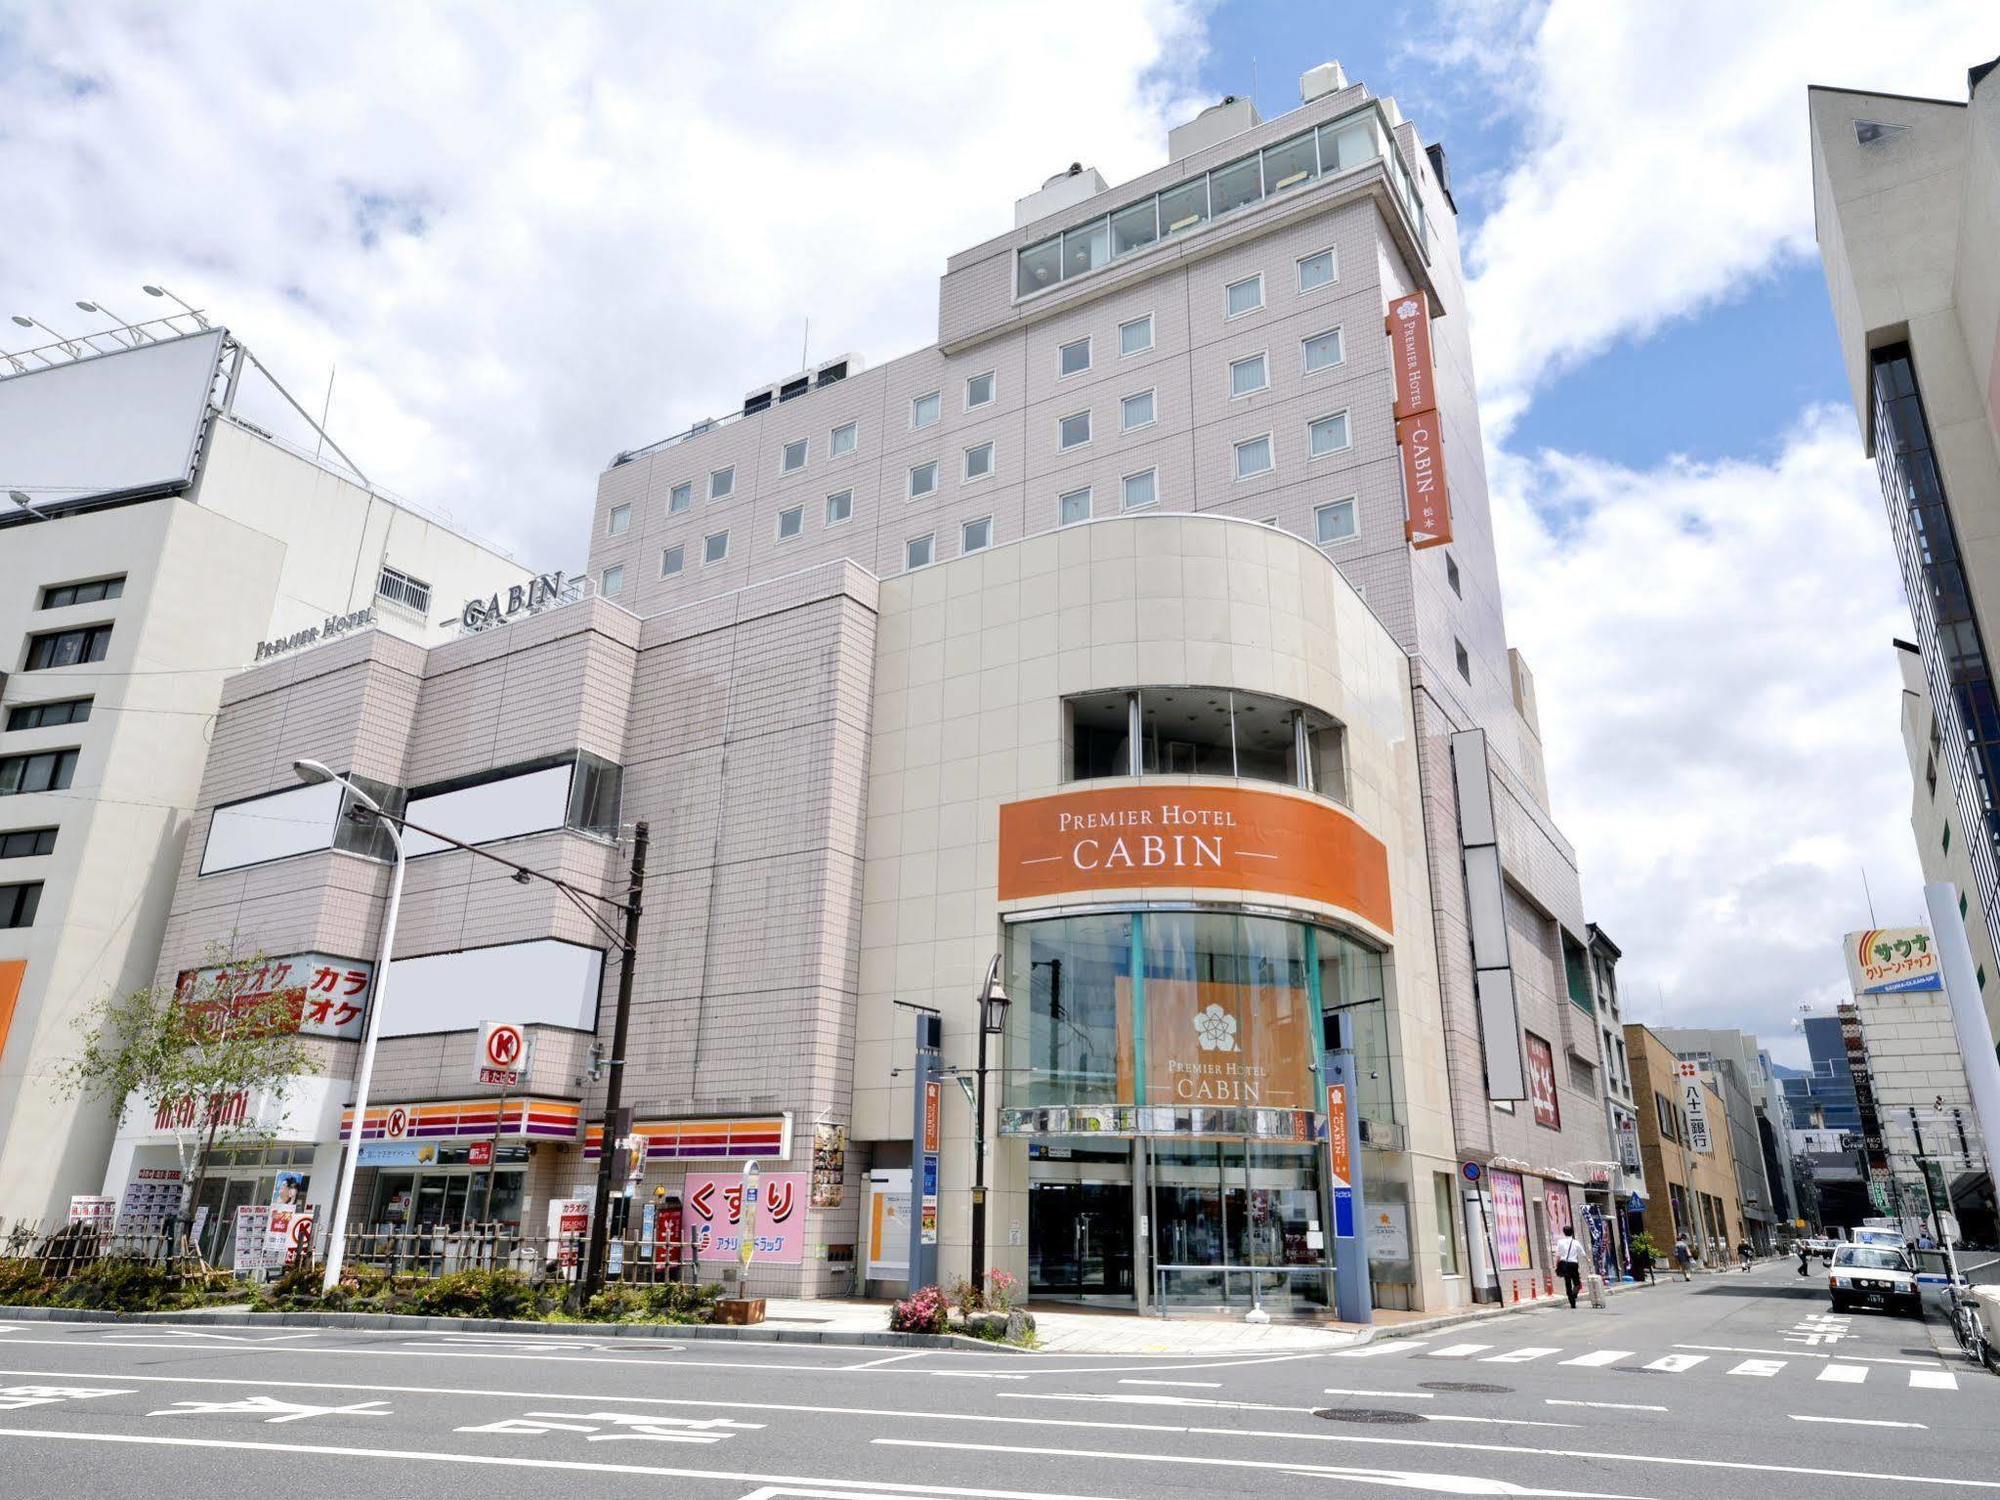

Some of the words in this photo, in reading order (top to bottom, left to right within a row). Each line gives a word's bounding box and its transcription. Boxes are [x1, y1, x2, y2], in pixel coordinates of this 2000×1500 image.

[1402, 320, 1418, 369] PREMIER
[1408, 368, 1423, 409] HOTEL
[1411, 429, 1435, 493] CABIN
[462, 570, 563, 627] CABIN
[254, 625, 319, 662] PREMIER
[321, 606, 376, 639] HOTEL
[1059, 810, 1153, 833] PREMIER
[1161, 804, 1237, 826] HOTEL
[1072, 835, 1225, 870] CABIN
[1873, 933, 1930, 963] サウナ
[310, 966, 368, 996] カラ
[308, 998, 363, 1026] オケ
[1168, 1059, 1222, 1076] PREMIER
[1226, 1062, 1267, 1077] HOTEL
[1177, 1079, 1260, 1102] CABIN
[1686, 1086, 1707, 1148] 八十二銀行
[563, 1204, 587, 1213] カラオケ
[691, 1182, 794, 1223] くすり
